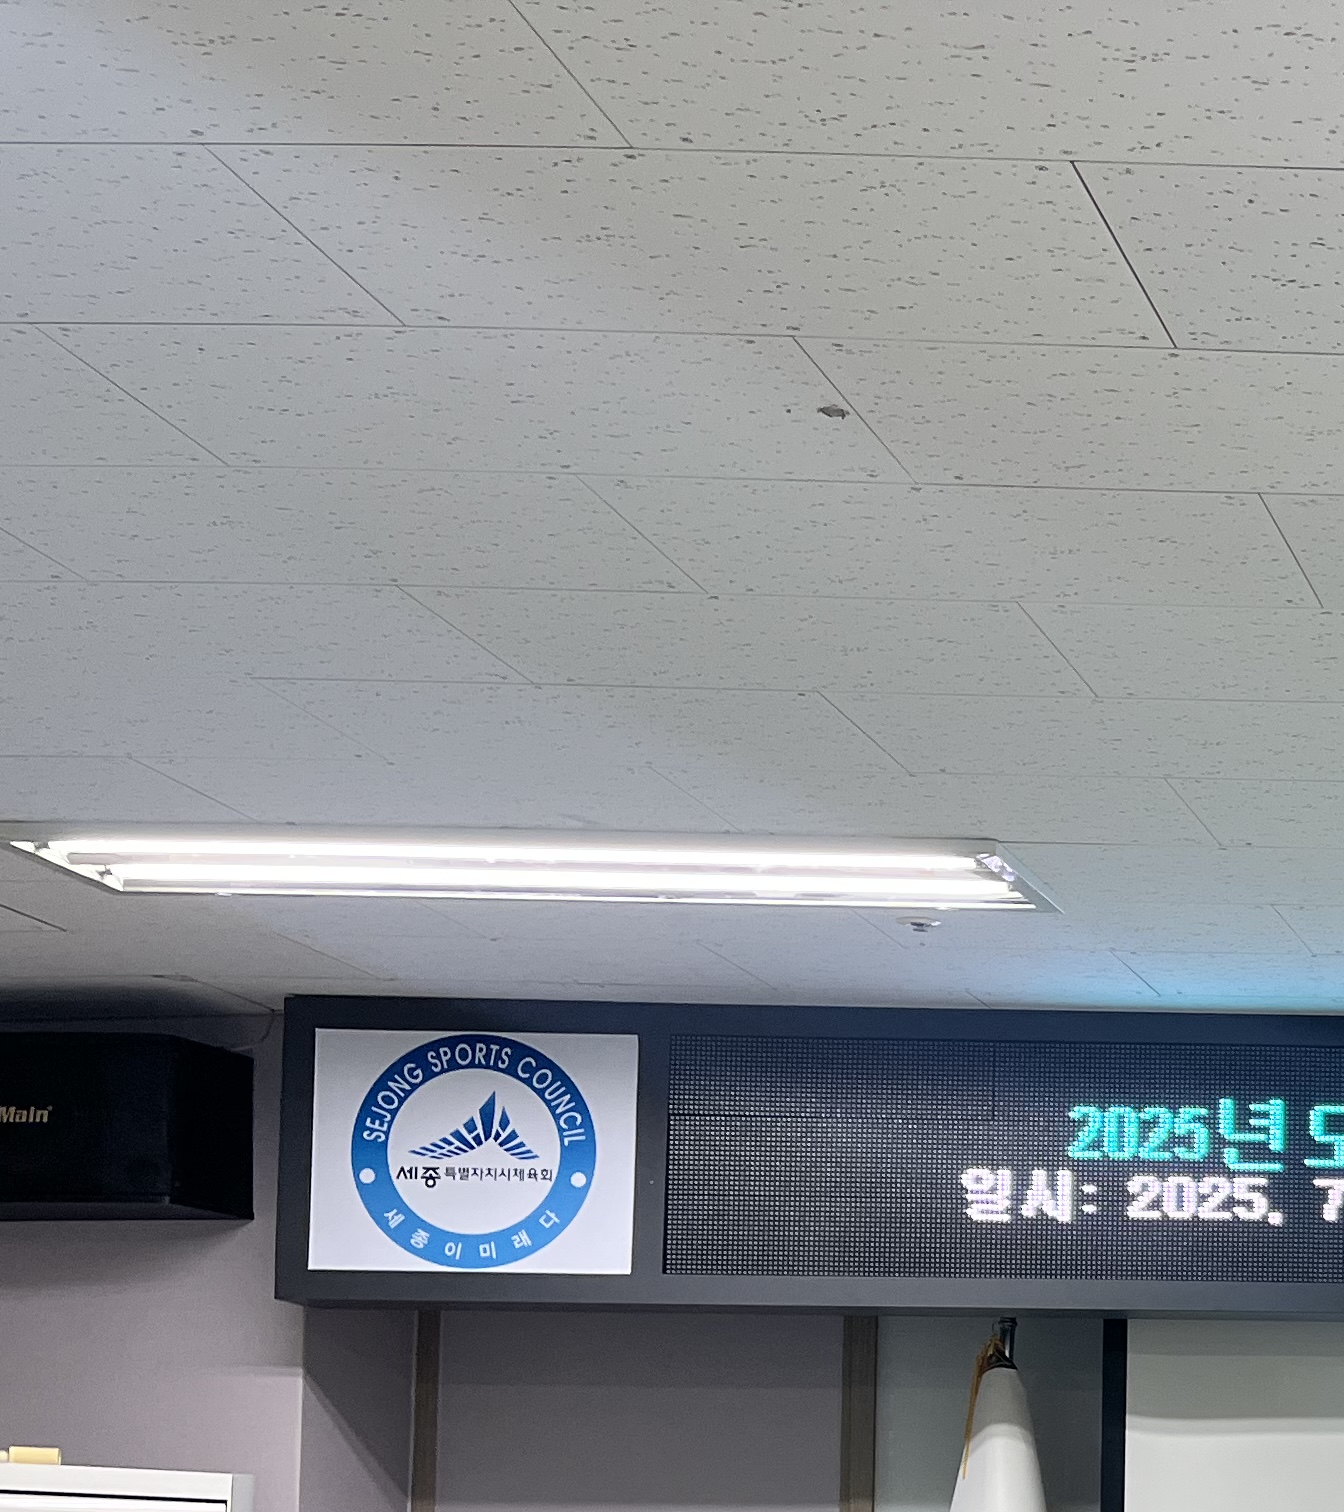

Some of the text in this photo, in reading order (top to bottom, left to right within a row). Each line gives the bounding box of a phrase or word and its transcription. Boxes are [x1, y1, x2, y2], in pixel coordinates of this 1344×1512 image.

[362, 1042, 587, 1147] SEJONG SPORTS COUNCIL
[957, 1165, 1099, 1226] 일시:
[1123, 1172, 1284, 1228] 2025.
